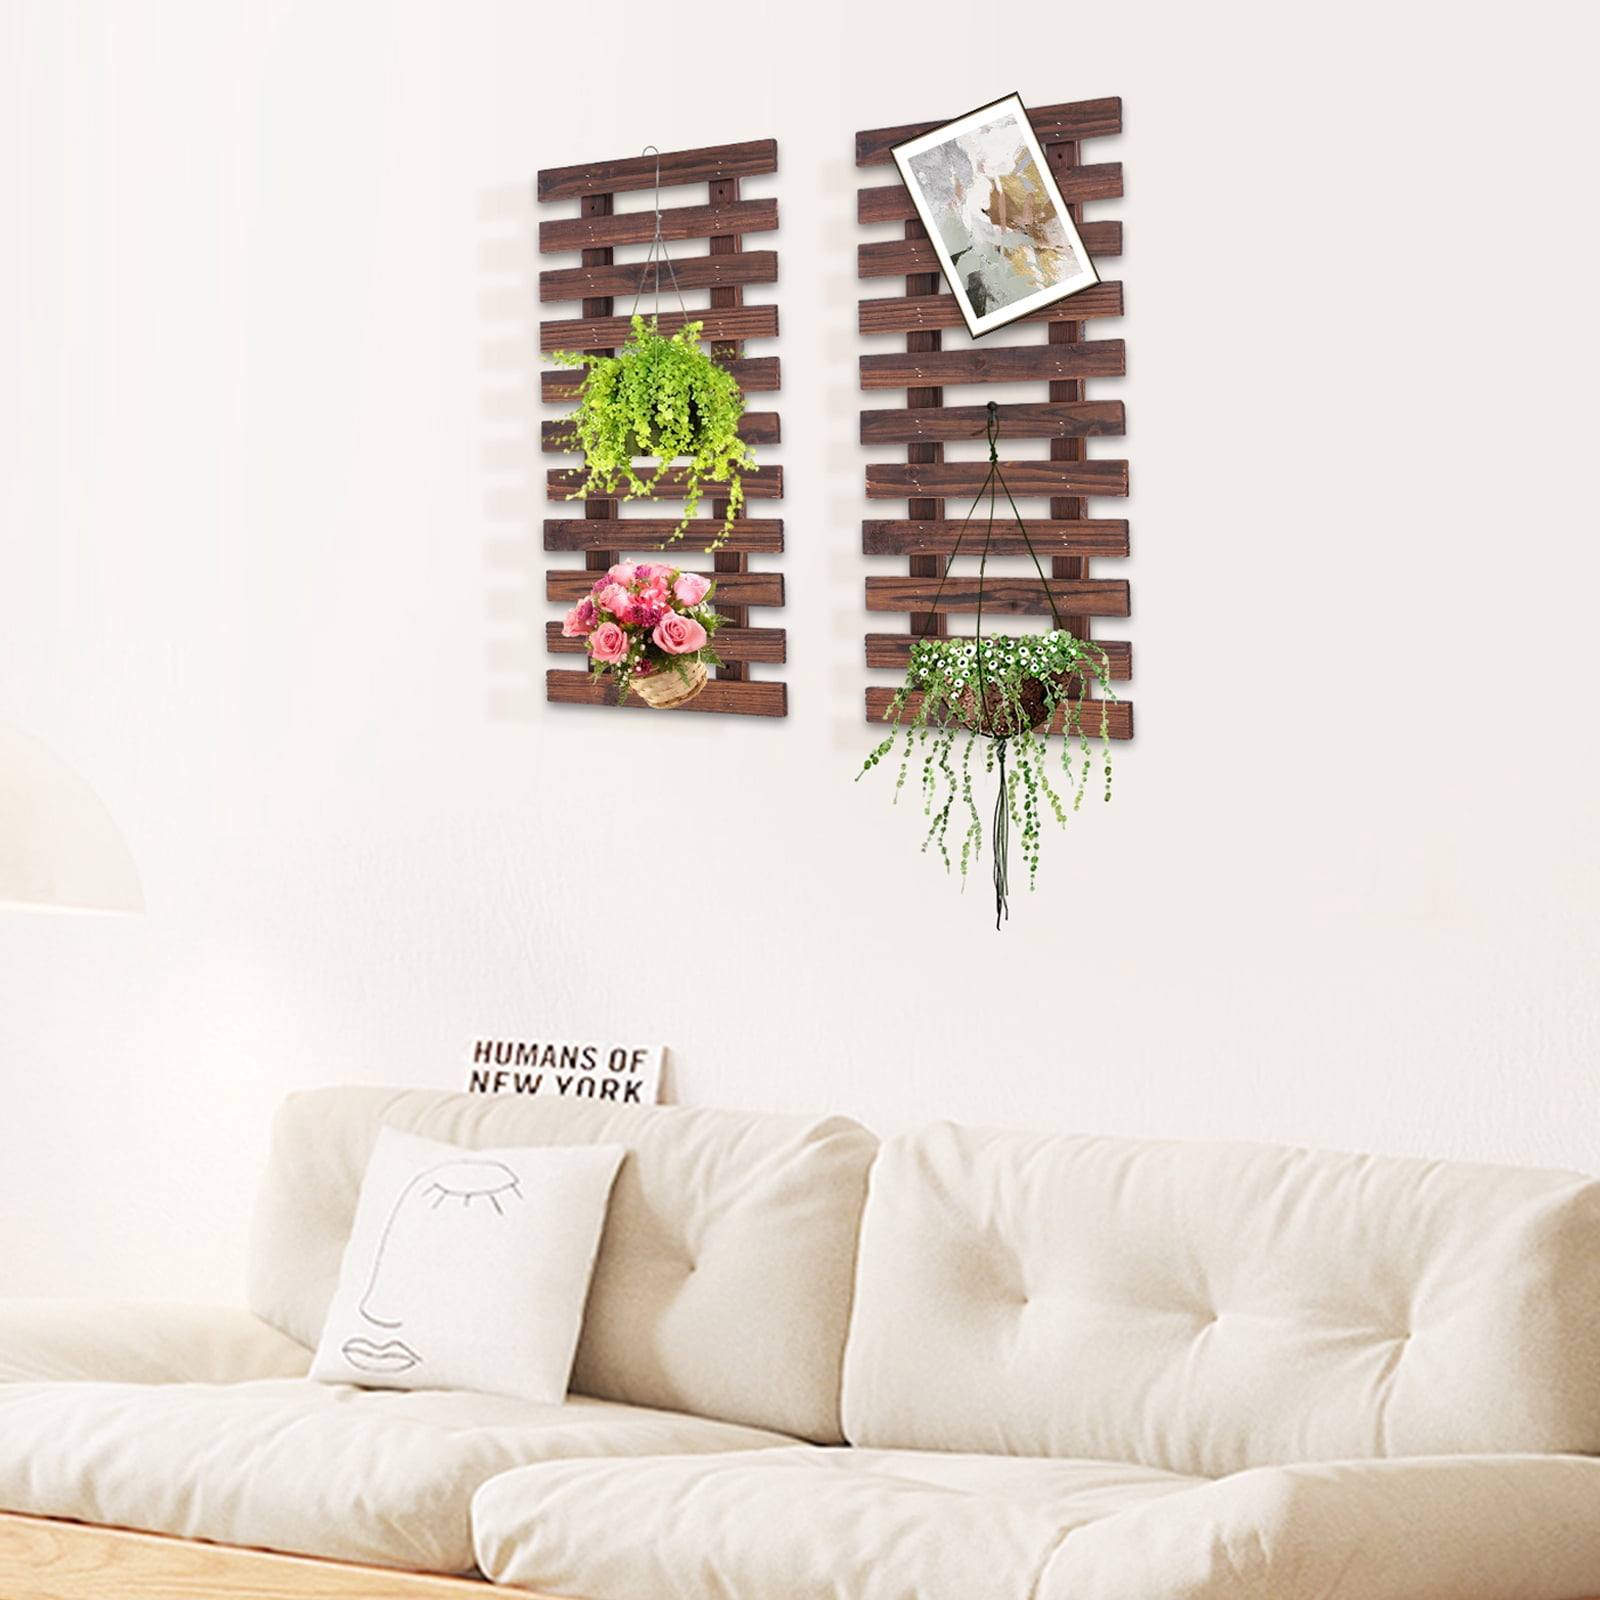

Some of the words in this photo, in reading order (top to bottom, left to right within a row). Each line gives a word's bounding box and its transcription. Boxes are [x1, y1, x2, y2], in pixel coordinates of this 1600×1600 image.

[474, 1041, 597, 1071] HUMANS
[608, 1048, 647, 1074] OF
[469, 1070, 543, 1094] NEW
[556, 1075, 643, 1103] YORK
